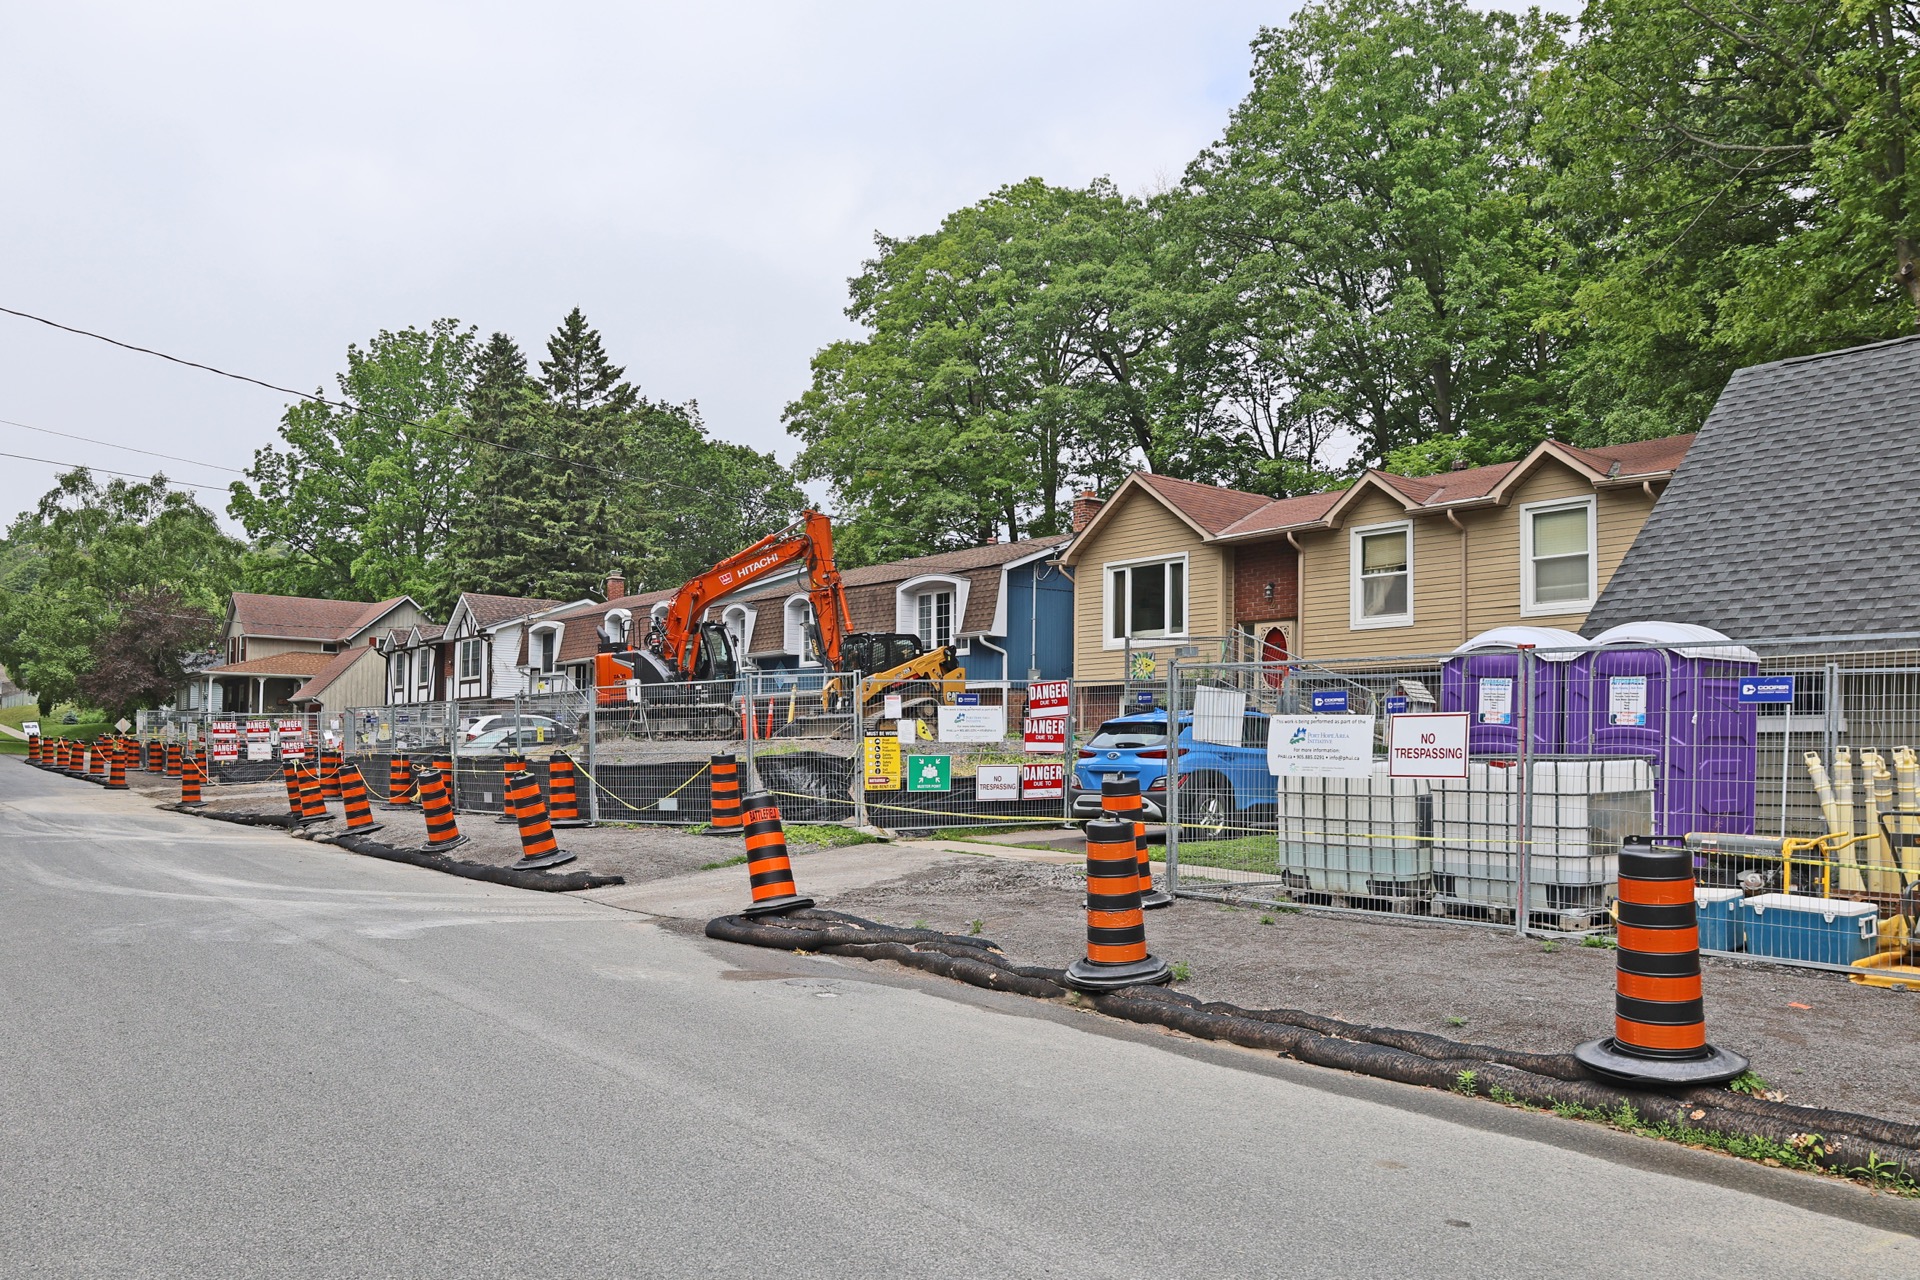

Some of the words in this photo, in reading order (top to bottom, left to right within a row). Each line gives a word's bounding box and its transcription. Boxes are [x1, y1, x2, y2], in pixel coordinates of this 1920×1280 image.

[737, 553, 779, 578] HITACHI
[1030, 683, 1068, 700] DANGER
[213, 722, 237, 730] DANGER
[246, 721, 270, 729] DANGER
[279, 720, 302, 728] DANGER
[1025, 719, 1065, 735] DANGER
[1420, 733, 1436, 744] NO
[213, 744, 237, 752] DANGER
[1395, 747, 1463, 759] TRESPASSING
[1024, 765, 1062, 780] DANGER
